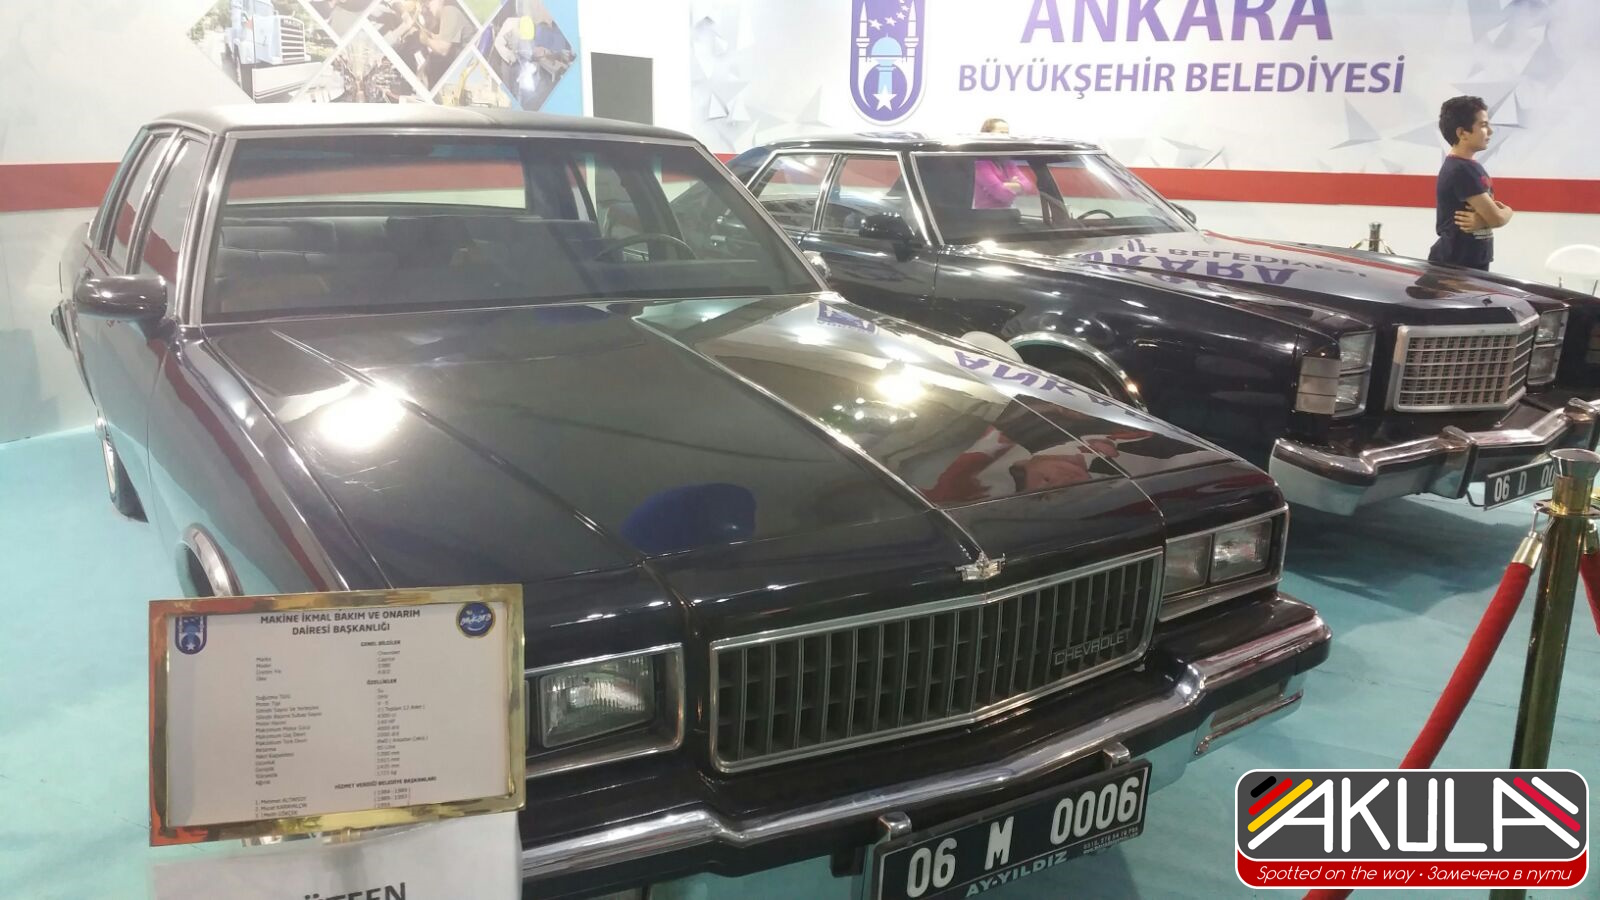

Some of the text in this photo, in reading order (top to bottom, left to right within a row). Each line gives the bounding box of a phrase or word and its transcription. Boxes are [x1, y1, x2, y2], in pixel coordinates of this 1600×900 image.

[1020, 0, 1333, 43] ANKARA
[958, 55, 1405, 99] BÜYÜKŞEHİR BELEDİYESİ
[1494, 475, 1511, 502] 06
[260, 609, 421, 624] MAKİNE İKMAL BAKIM VE ONARIM
[292, 622, 390, 636] DAİRESİ BAŞKANLIĞI
[1054, 628, 1131, 666] CHEVROLET
[906, 776, 1140, 899] 06 M 0006
[965, 850, 1068, 899] AY-YILDIZ
